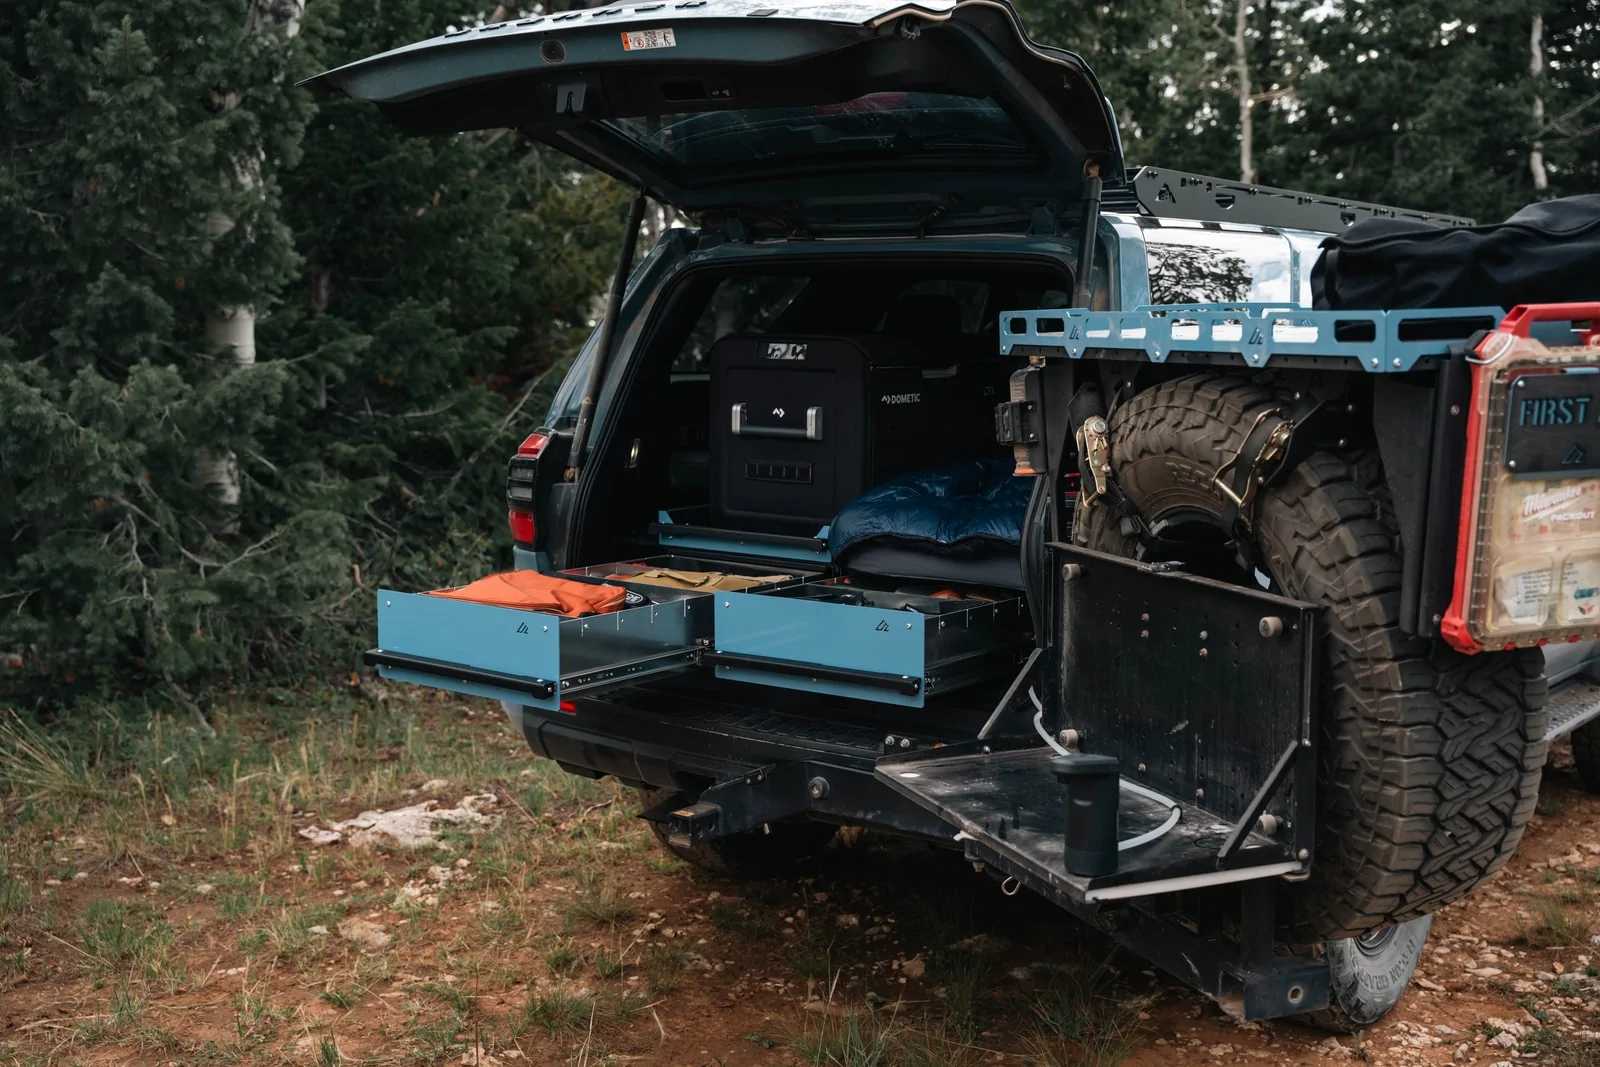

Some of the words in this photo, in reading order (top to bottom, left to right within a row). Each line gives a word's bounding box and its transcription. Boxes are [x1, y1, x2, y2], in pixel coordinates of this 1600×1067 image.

[891, 393, 921, 404] DOMETIC
[1519, 398, 1591, 425] FIRST
[1522, 487, 1582, 514] Milwaukee
[1551, 511, 1596, 522] PACKOUT
